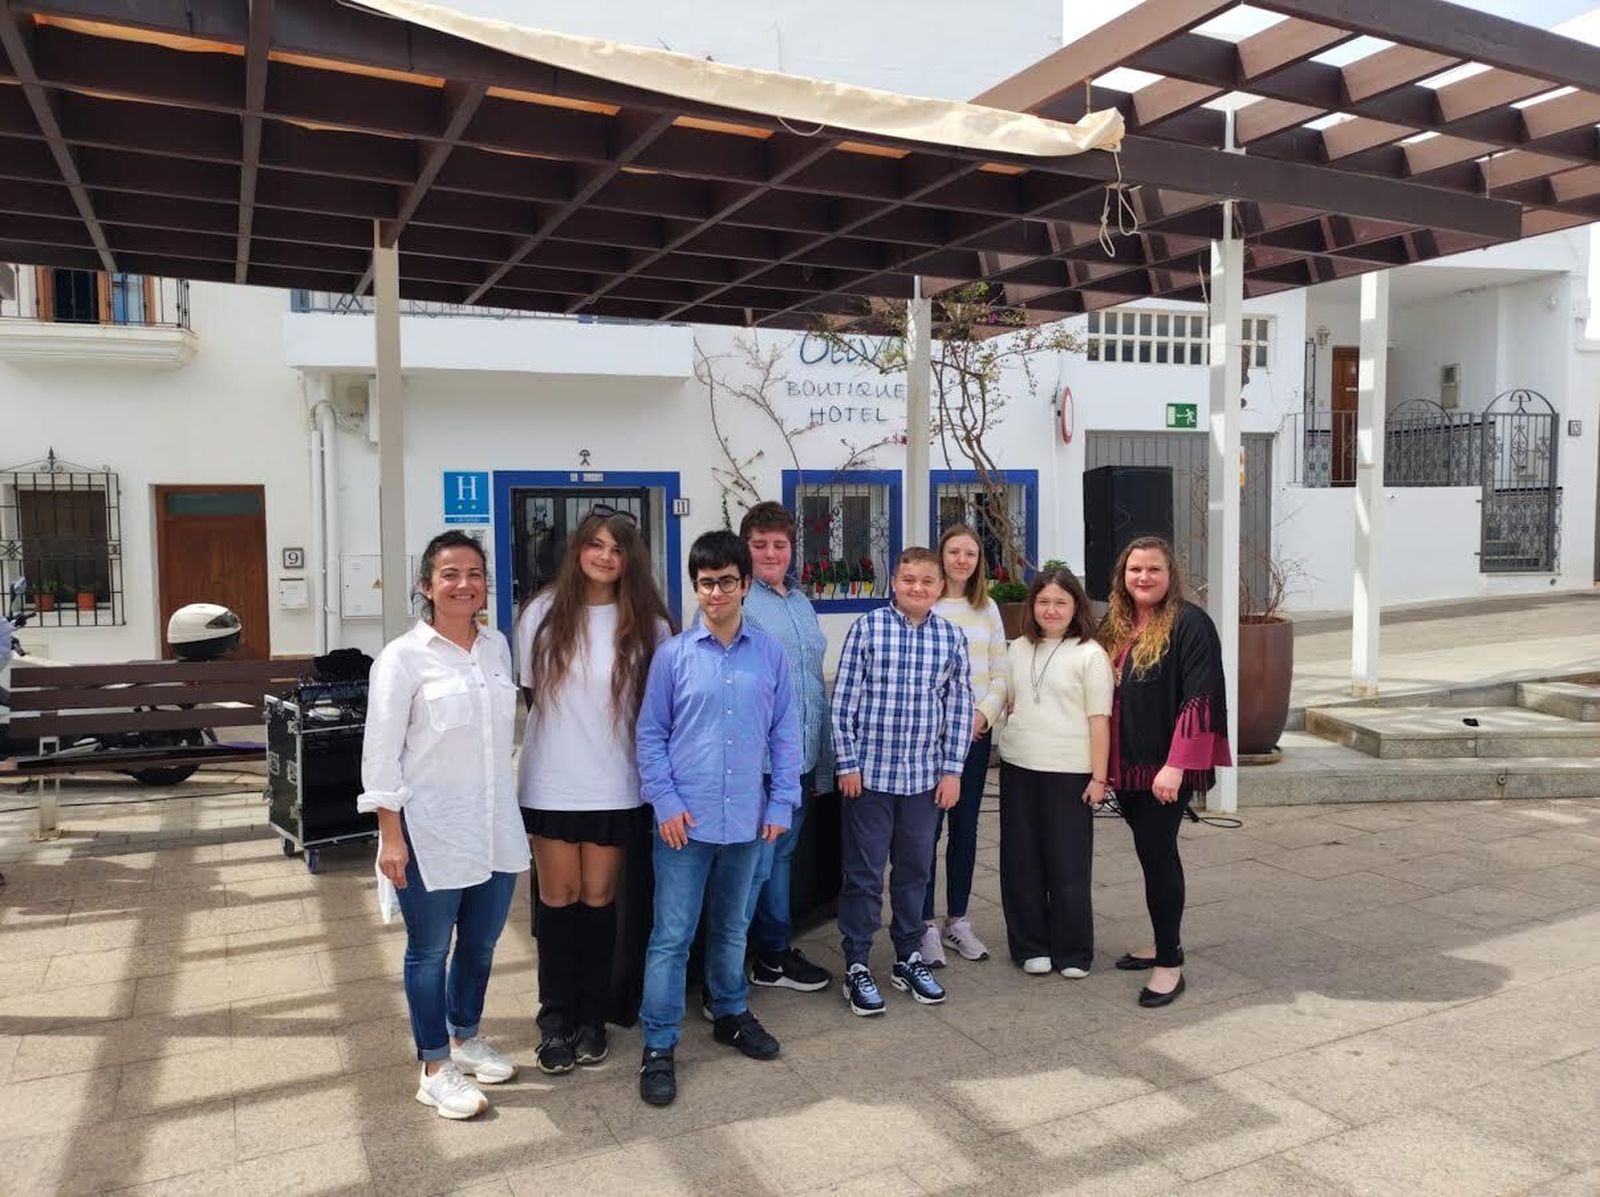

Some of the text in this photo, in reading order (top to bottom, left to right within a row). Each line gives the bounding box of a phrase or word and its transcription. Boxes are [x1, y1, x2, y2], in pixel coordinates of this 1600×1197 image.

[786, 380, 906, 399] BOUTIQUE
[810, 405, 888, 422] HOTEL
[456, 475, 478, 500] H
[288, 552, 299, 565] 9
